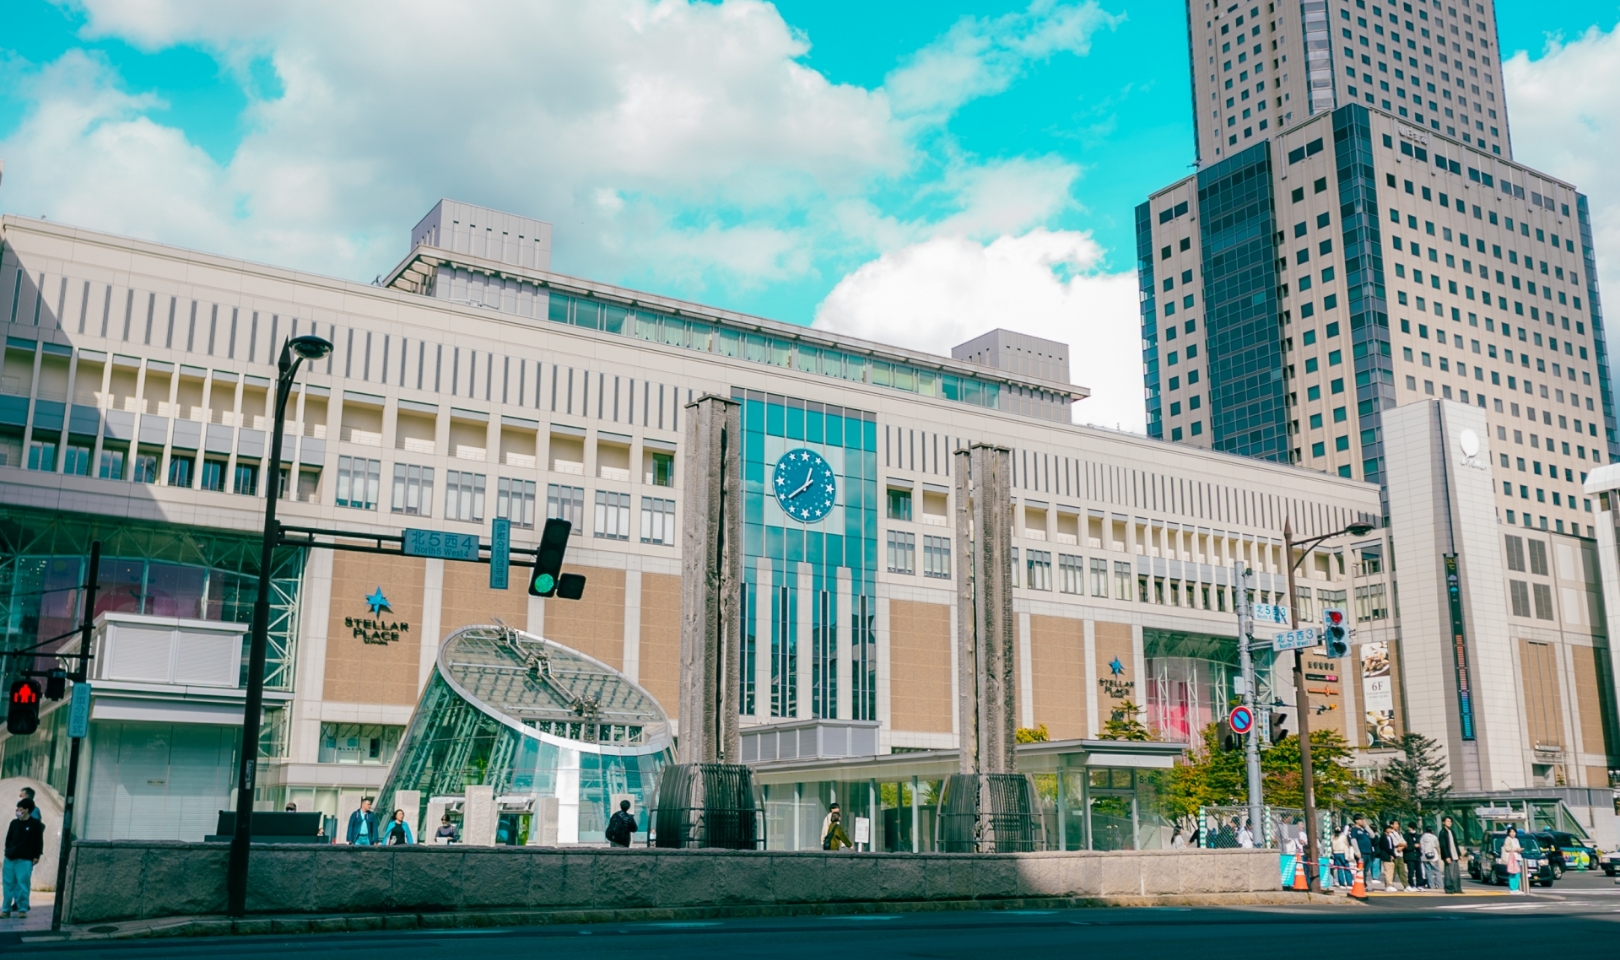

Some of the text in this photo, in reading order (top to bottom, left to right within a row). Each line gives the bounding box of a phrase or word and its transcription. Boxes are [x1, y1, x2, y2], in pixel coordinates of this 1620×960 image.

[411, 531, 473, 550] 北5西4
[345, 616, 409, 632] STELLAR
[353, 627, 400, 642] PLACE
[1276, 629, 1314, 643] 北5西3
[1371, 681, 1384, 691] 6F
